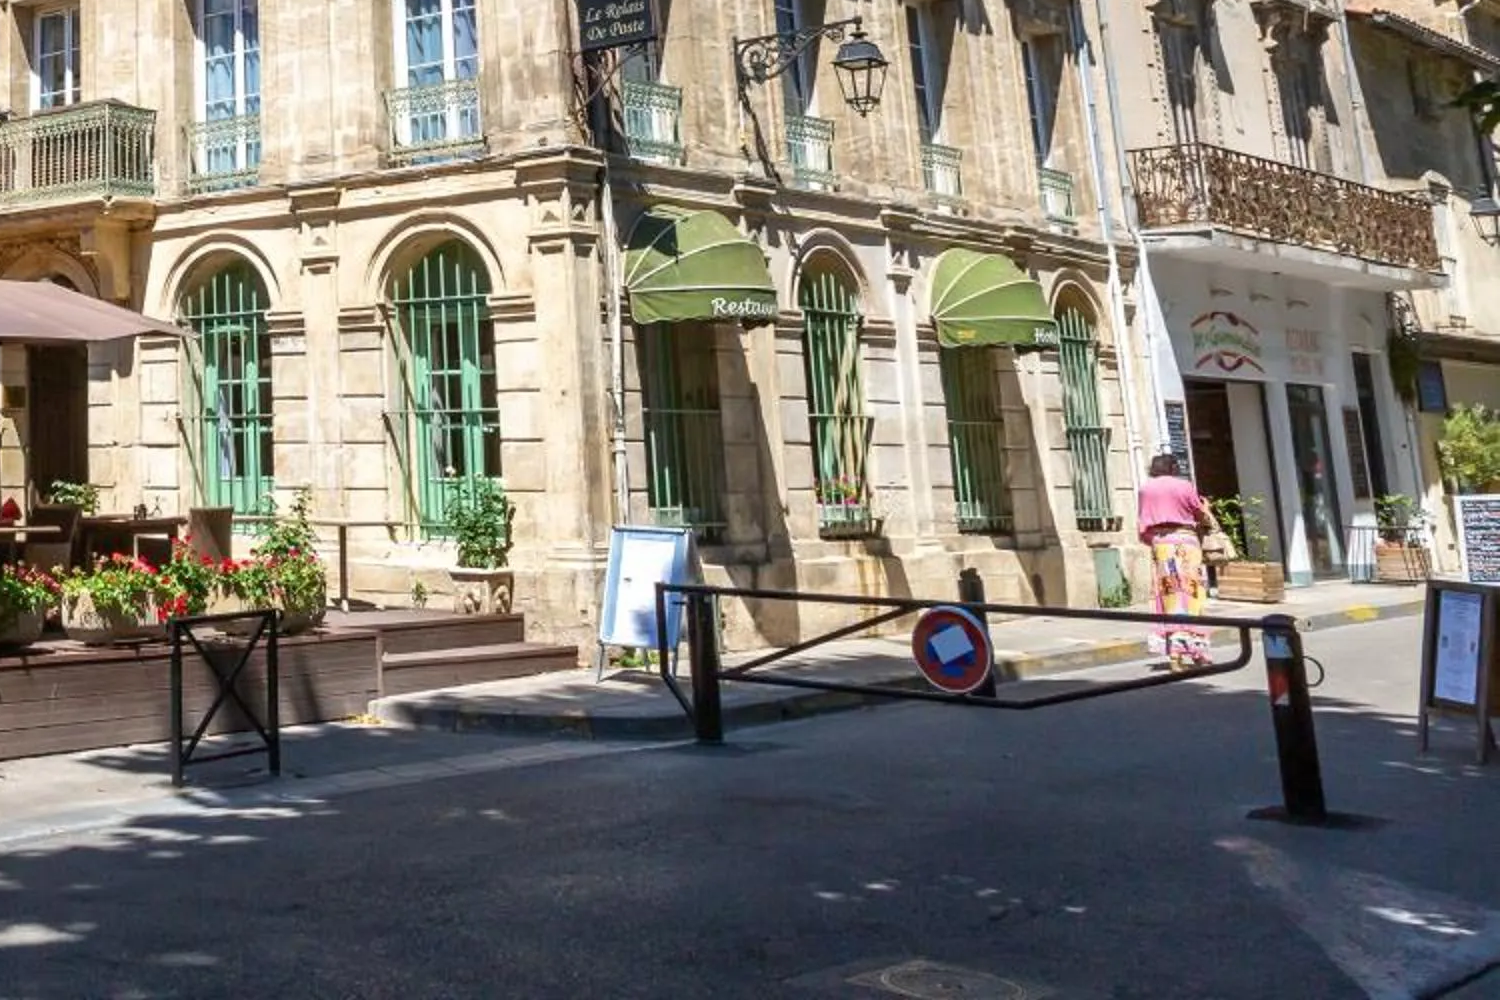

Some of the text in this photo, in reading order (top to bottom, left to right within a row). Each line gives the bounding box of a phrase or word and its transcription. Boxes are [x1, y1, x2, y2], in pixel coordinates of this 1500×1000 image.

[585, 6, 602, 22] Le
[586, 20, 645, 40] De Poste
